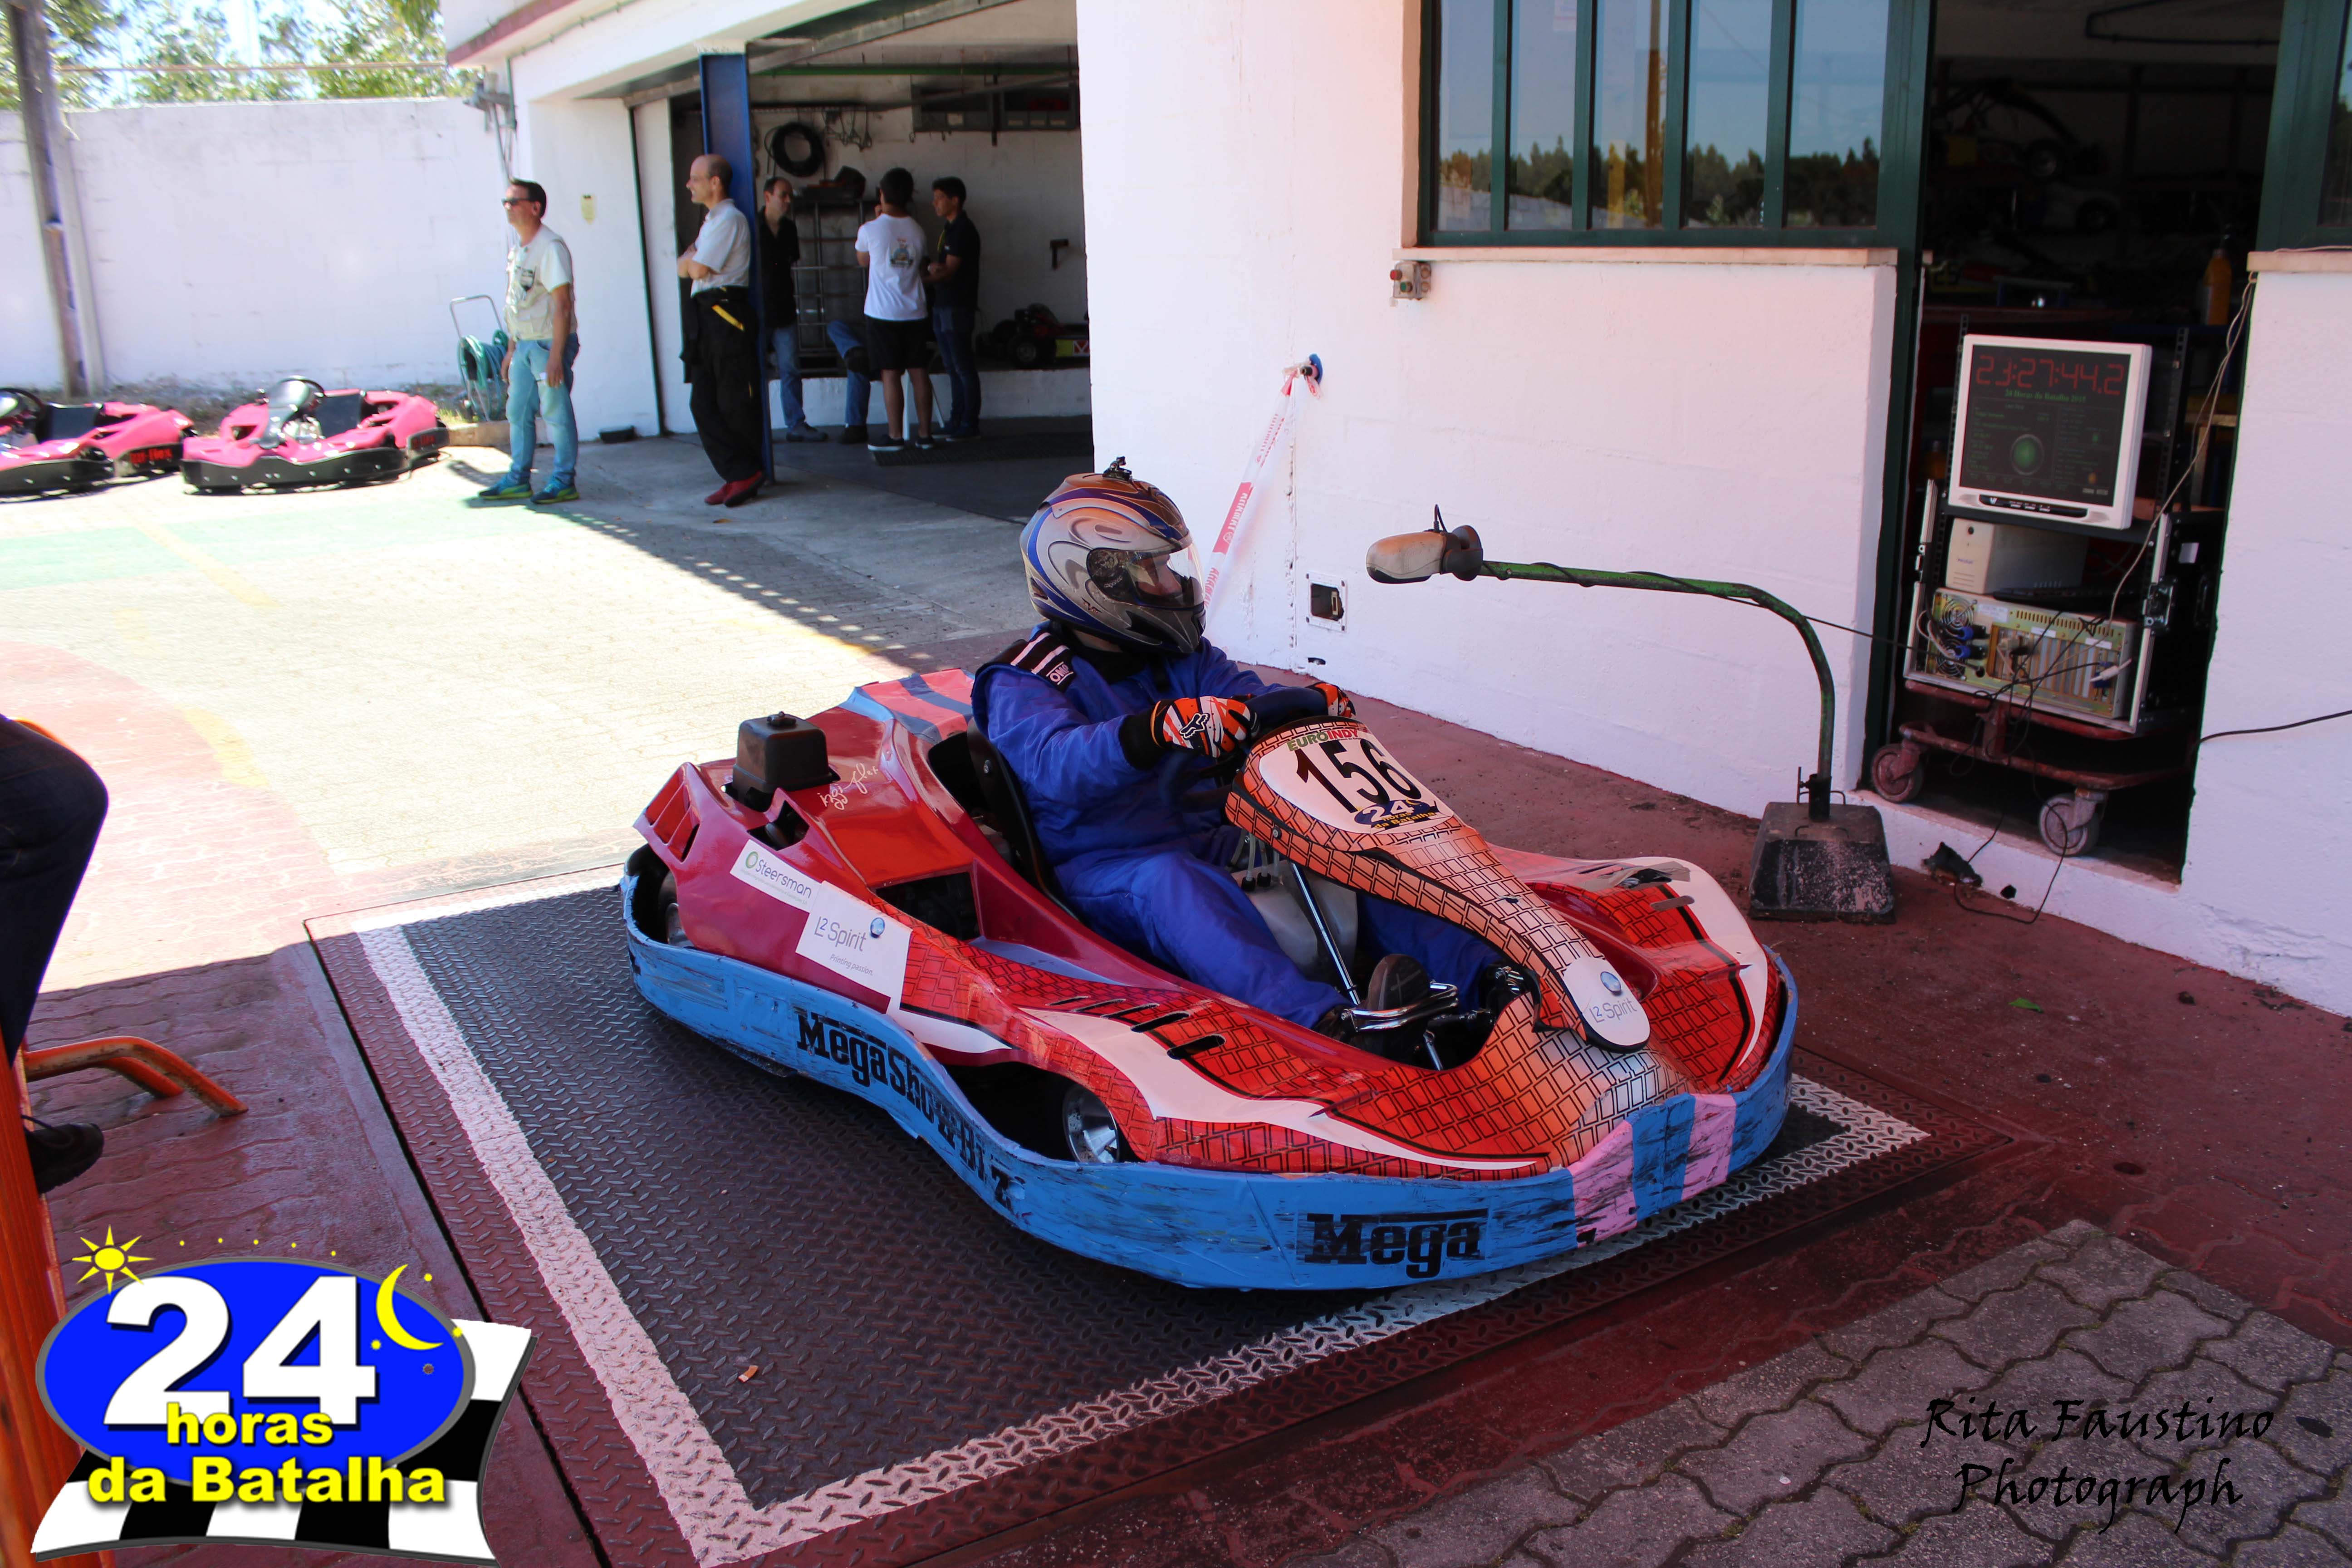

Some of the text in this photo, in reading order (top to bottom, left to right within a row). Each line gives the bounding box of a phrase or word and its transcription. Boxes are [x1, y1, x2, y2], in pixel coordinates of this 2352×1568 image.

[1050, 664, 1070, 682] OMP
[1287, 727, 1358, 752] EUROINDY
[1294, 739, 1422, 813] 156
[1362, 800, 1415, 823] 24
[1382, 812, 1411, 821] horas
[1391, 812, 1436, 824] Batalha
[755, 859, 812, 898] Steersman
[828, 922, 867, 951] Spirit
[830, 954, 852, 969] Printing
[1602, 998, 1637, 1020] Spirit
[1304, 1208, 1489, 1279] Mega
